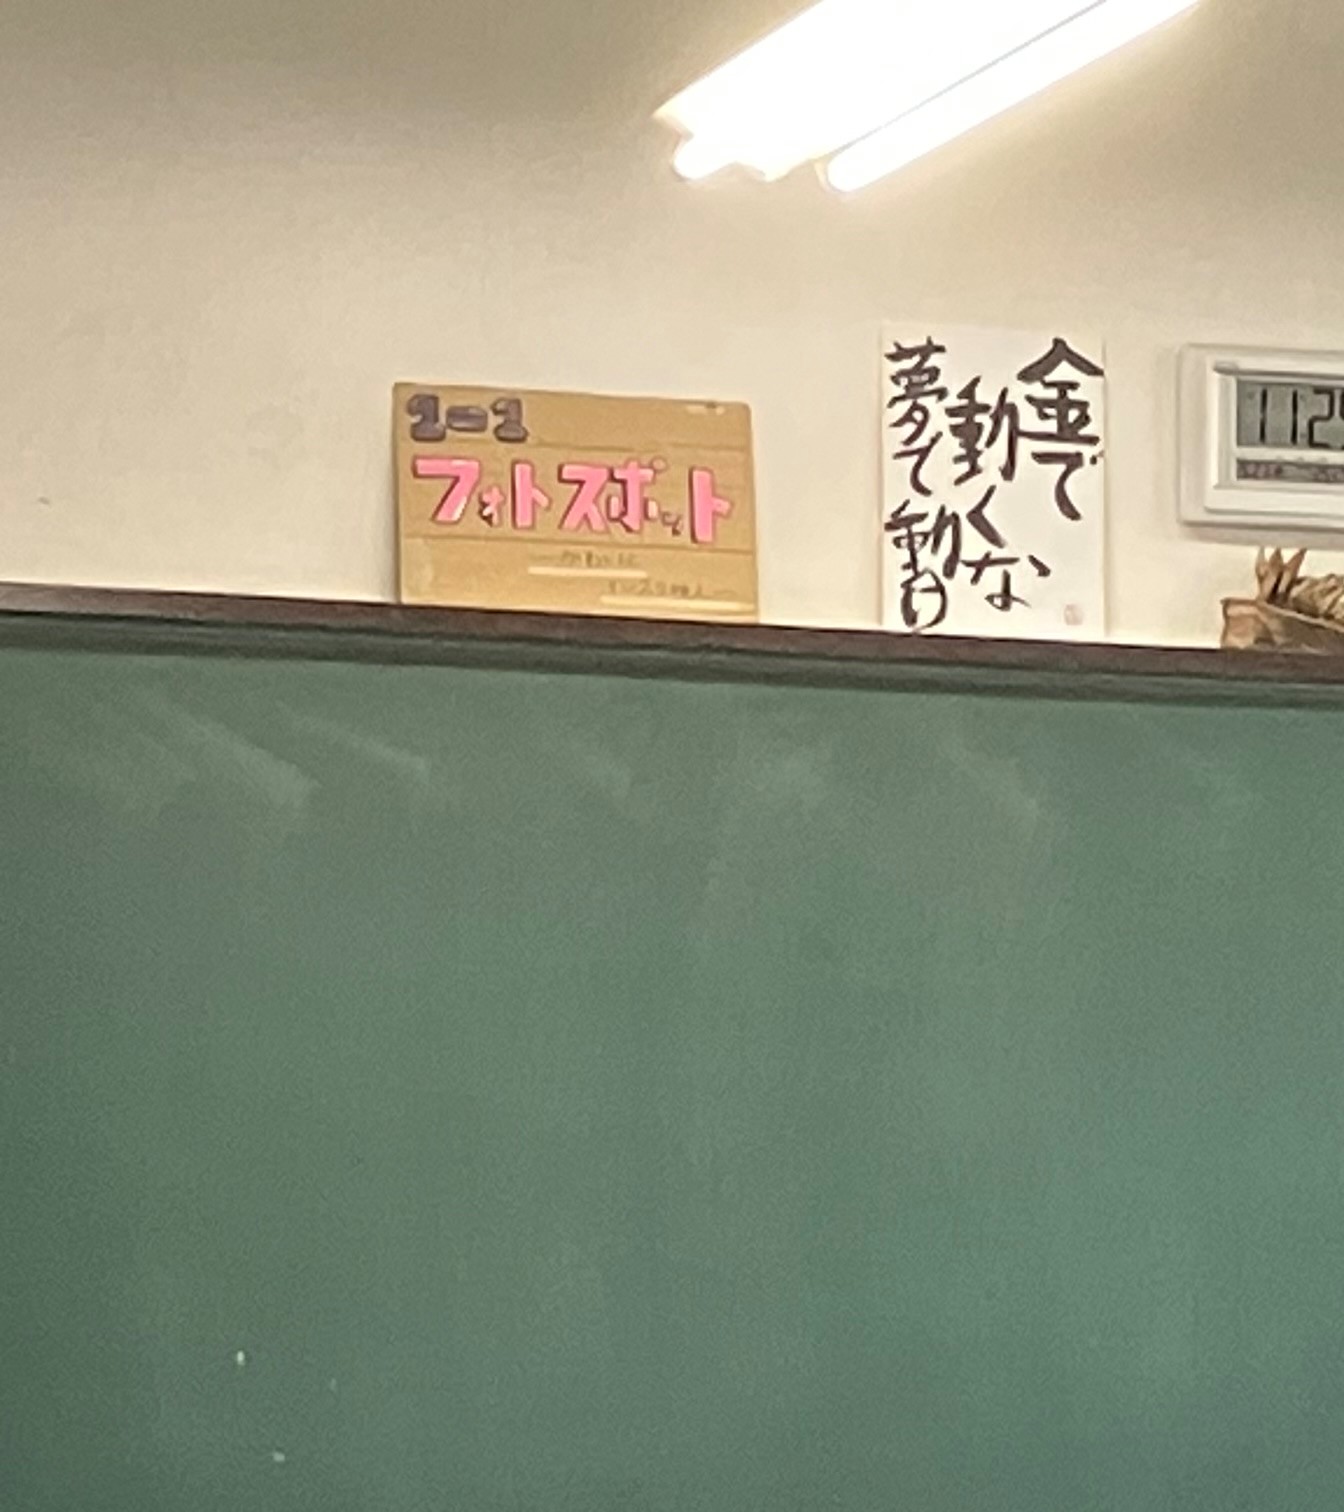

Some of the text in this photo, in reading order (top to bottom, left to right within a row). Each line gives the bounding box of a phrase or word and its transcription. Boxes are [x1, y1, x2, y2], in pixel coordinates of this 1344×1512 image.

[1017, 337, 1104, 521] 金で
[412, 456, 734, 544] フォトスポット
